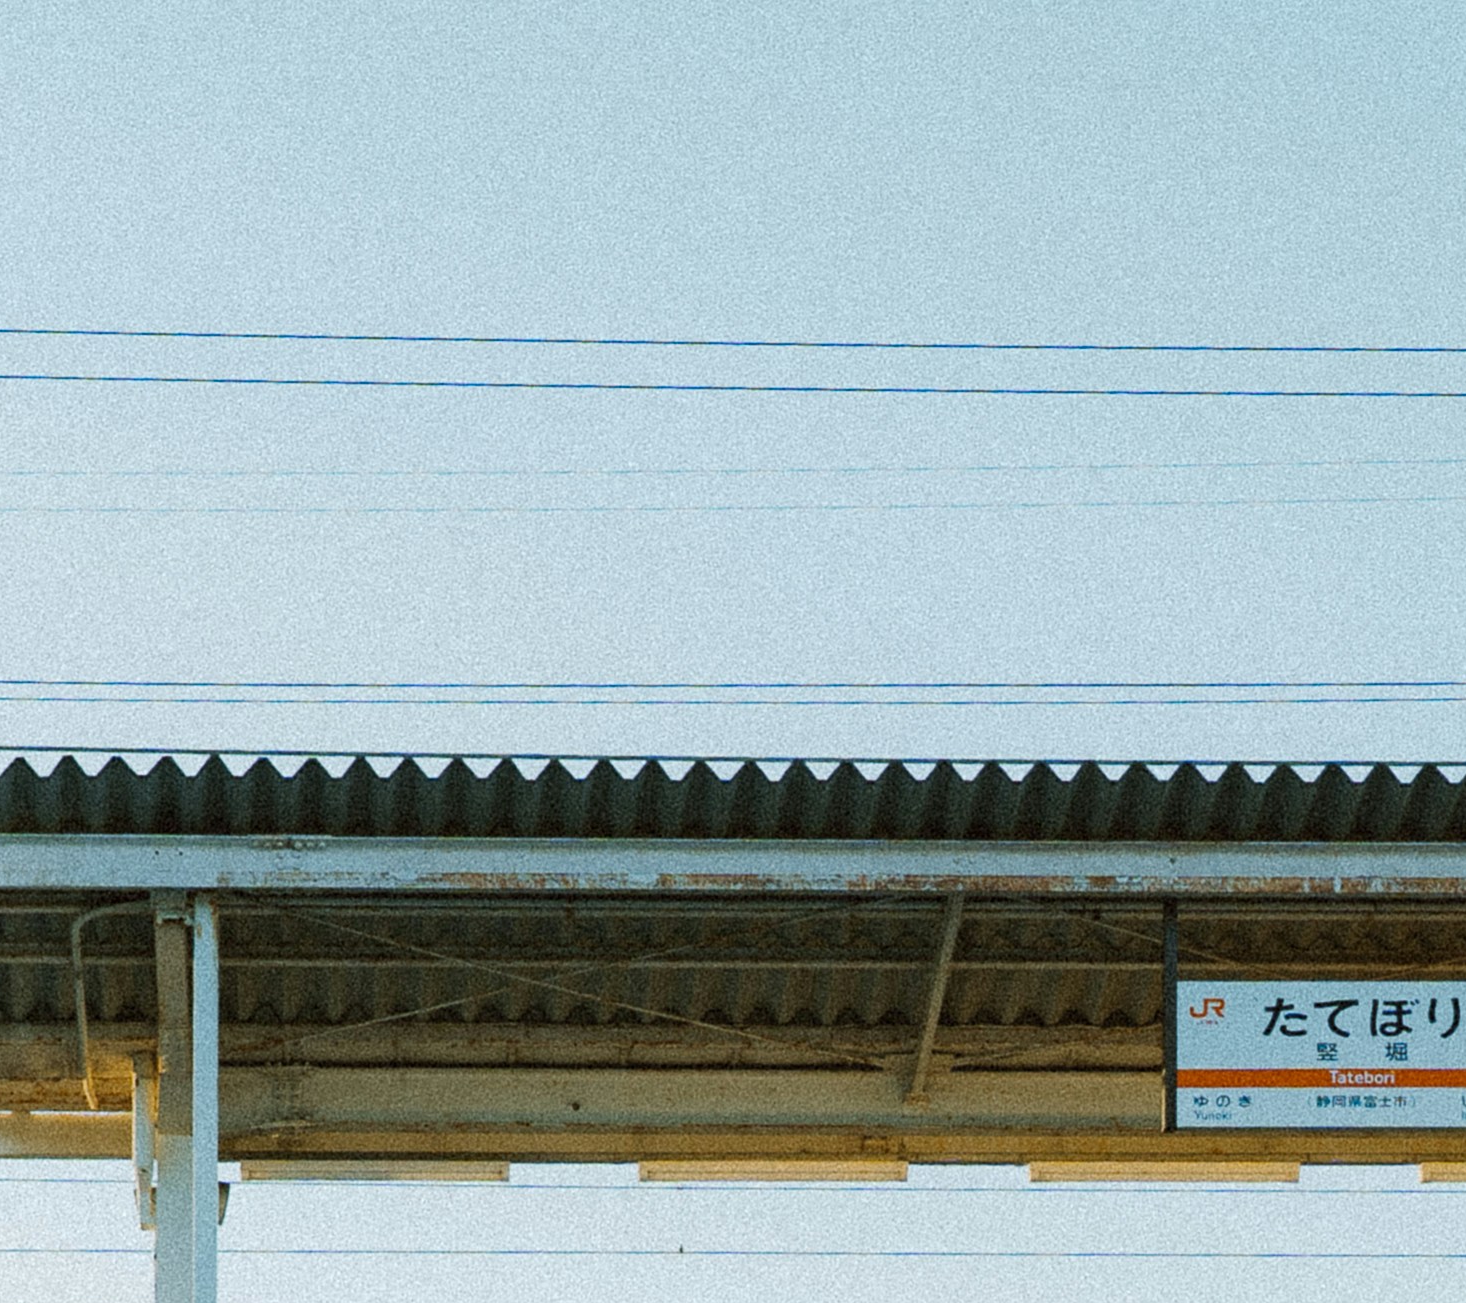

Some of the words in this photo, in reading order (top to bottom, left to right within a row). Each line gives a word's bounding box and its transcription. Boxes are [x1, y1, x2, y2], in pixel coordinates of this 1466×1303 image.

[1189, 997, 1225, 1018] JR
[1262, 997, 1462, 1038] たてぼり
[1329, 1069, 1396, 1085] Tatebori
[1193, 1094, 1252, 1108] ゆのき
